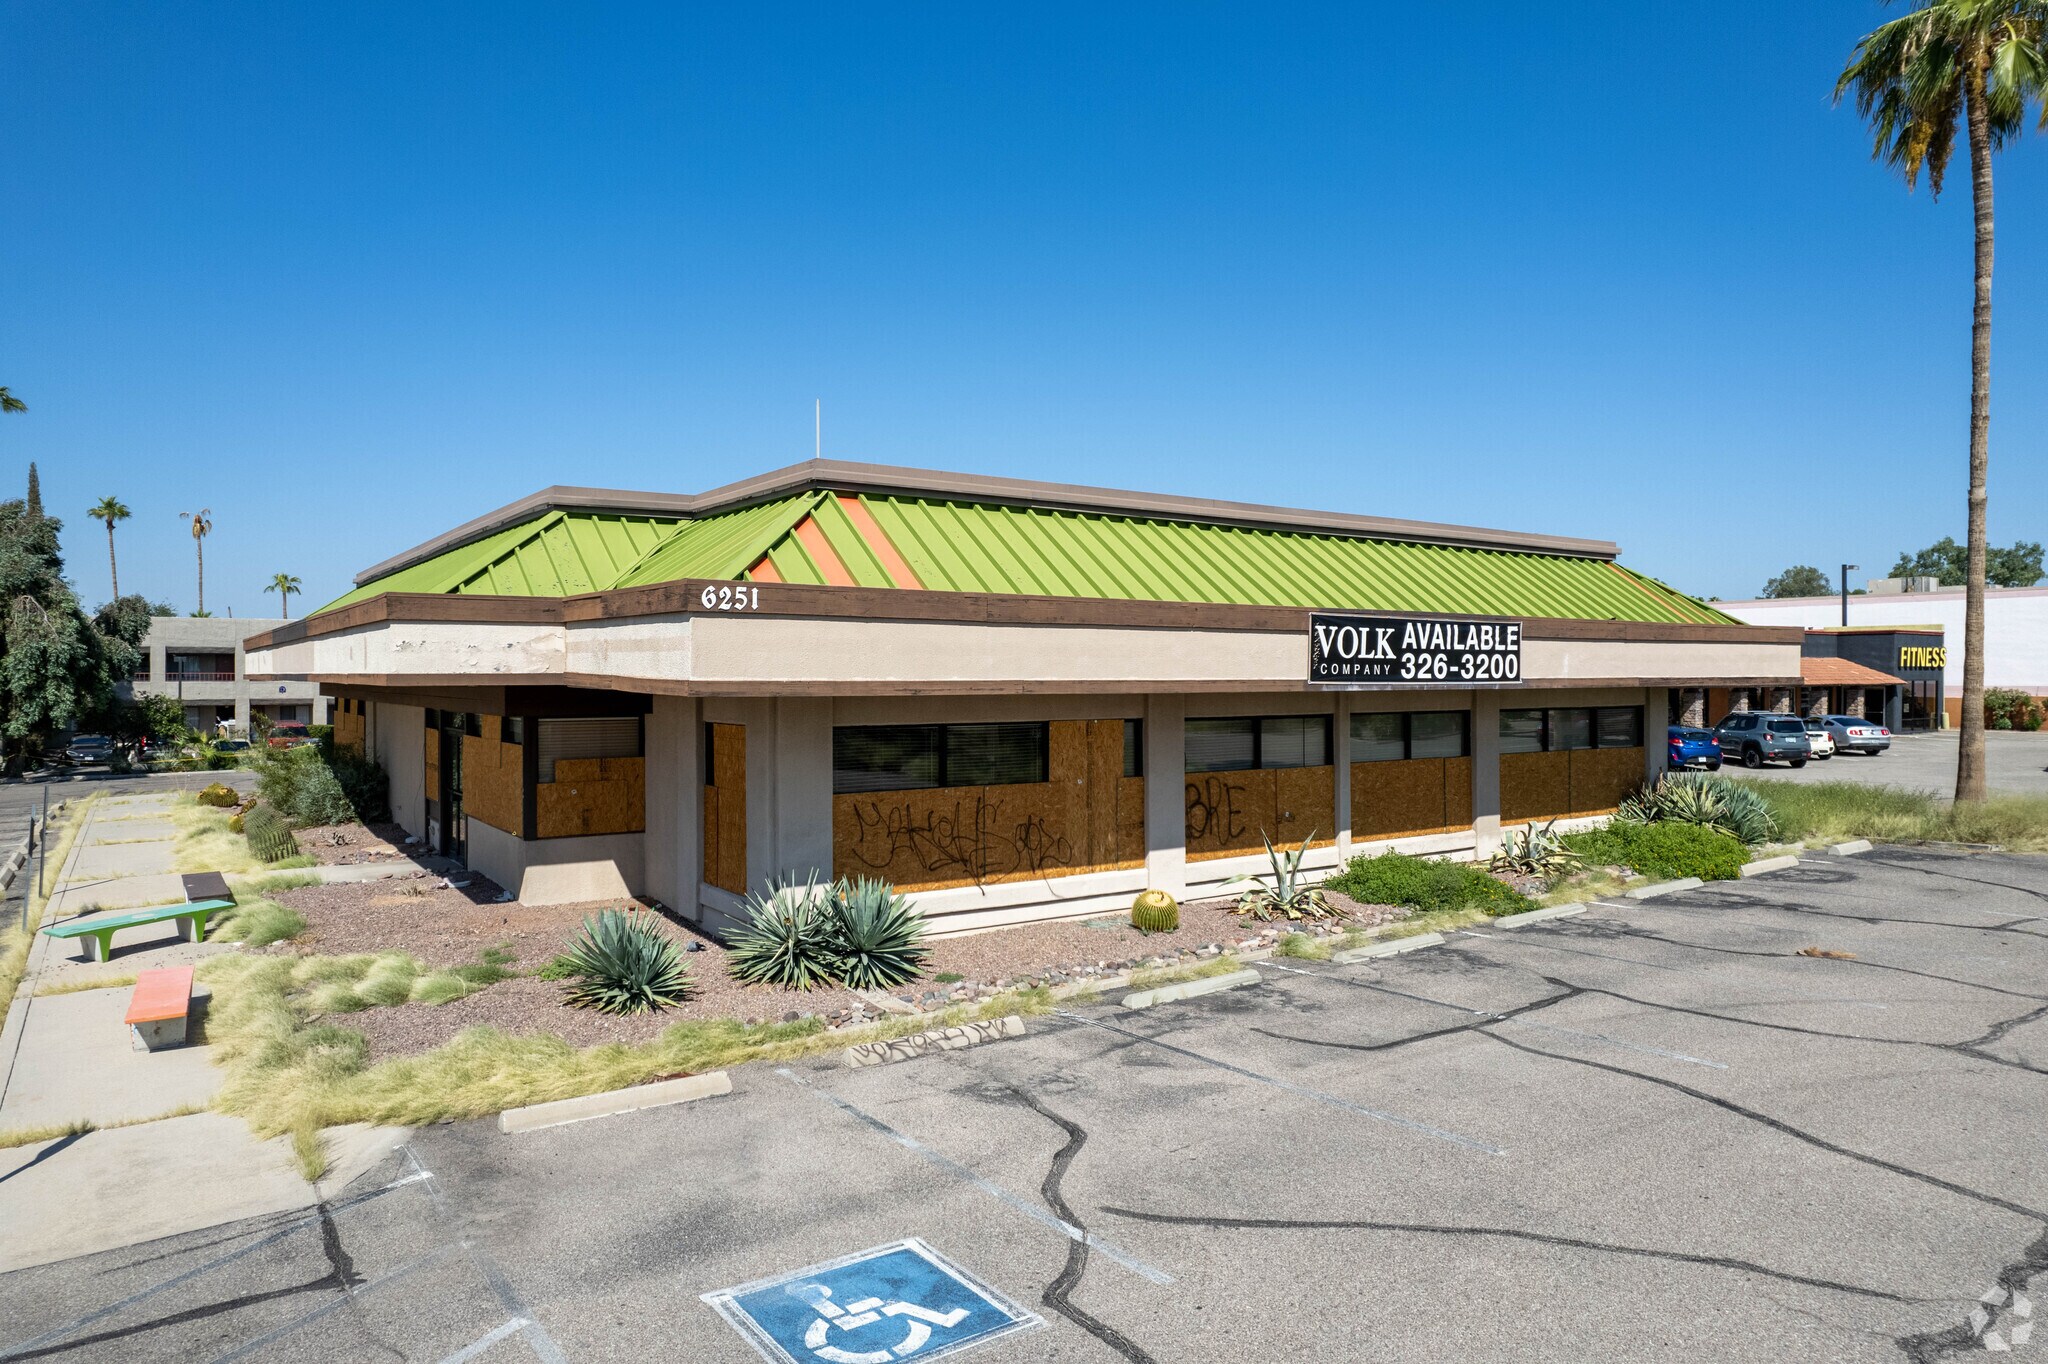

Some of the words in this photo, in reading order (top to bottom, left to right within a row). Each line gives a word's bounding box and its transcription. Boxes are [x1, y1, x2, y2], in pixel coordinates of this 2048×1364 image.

[701, 585, 759, 610] 6251
[1315, 625, 1397, 659] VOLK
[1402, 622, 1519, 650] AVAILABLE
[1320, 663, 1391, 675] COMPANY
[1400, 652, 1519, 679] 326-3200
[1900, 647, 1947, 667] FITNESS
